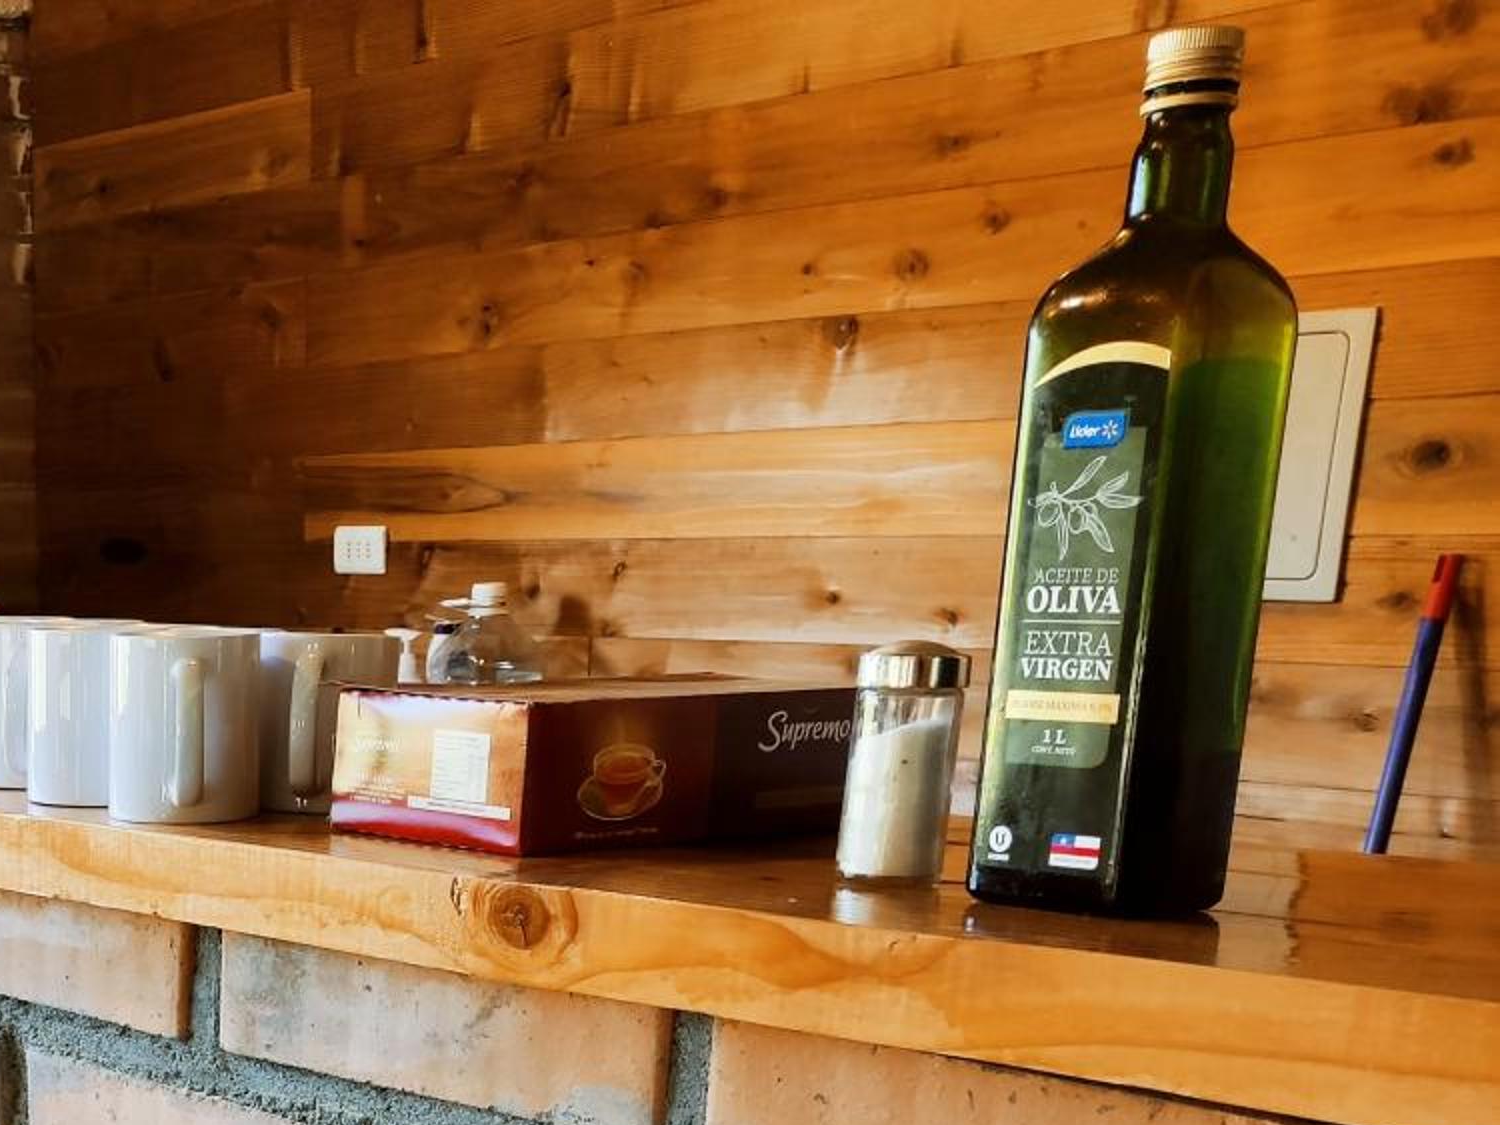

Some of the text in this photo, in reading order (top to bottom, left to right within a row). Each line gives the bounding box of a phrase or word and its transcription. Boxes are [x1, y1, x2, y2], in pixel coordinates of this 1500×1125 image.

[1033, 567, 1120, 583] ACEITE DE
[1026, 585, 1121, 614] OLIVA
[1024, 630, 1113, 657] EXTRA
[1020, 657, 1113, 681] VIRGEN
[758, 711, 851, 752] Supremo
